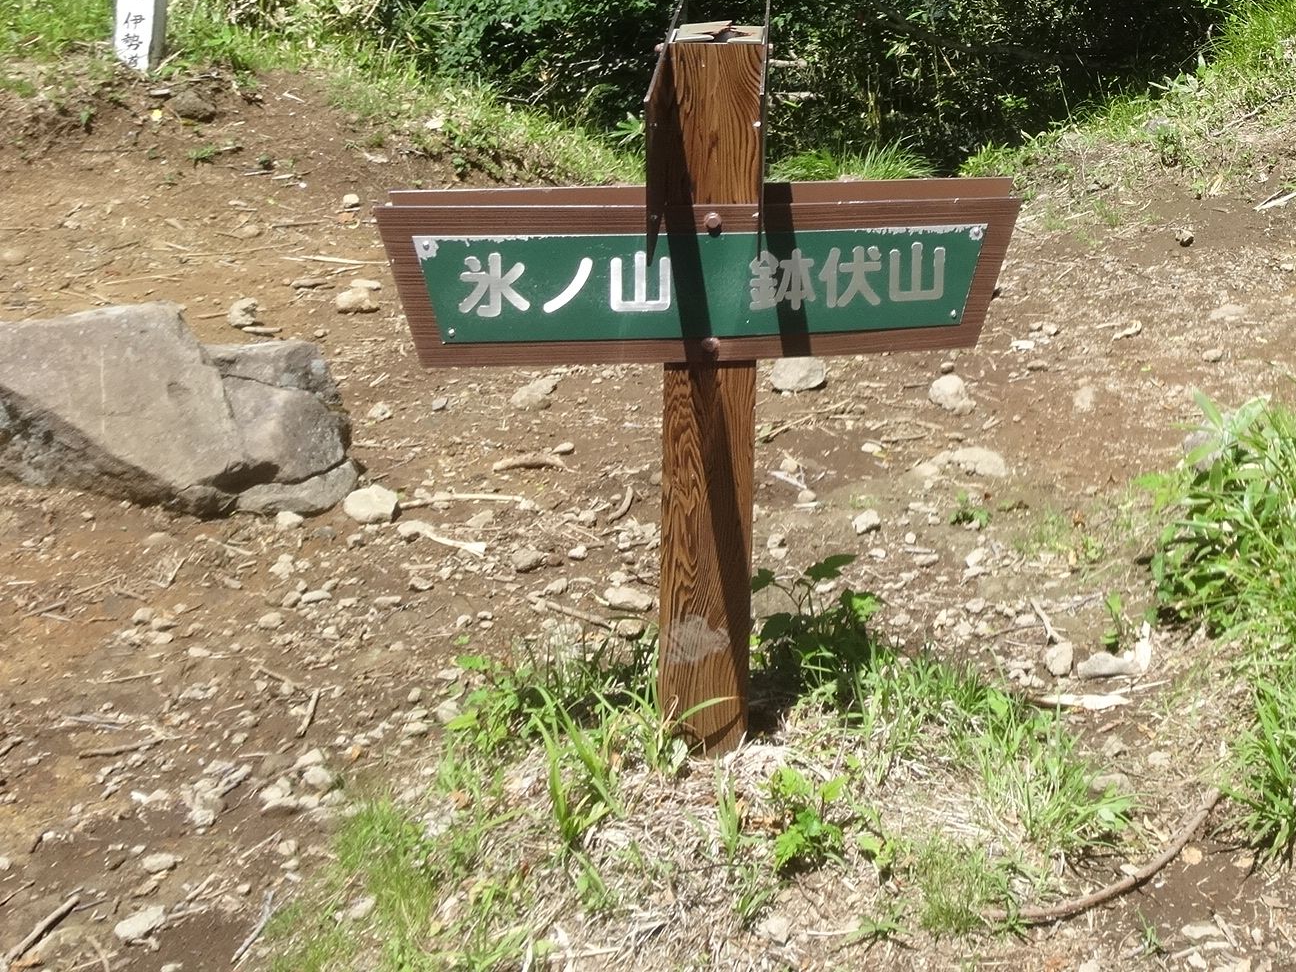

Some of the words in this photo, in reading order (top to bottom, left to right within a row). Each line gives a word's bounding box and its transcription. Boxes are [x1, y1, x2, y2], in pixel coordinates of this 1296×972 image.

[458, 250, 671, 318] 氷ノ山
[748, 242, 946, 312] 鉢伏山
